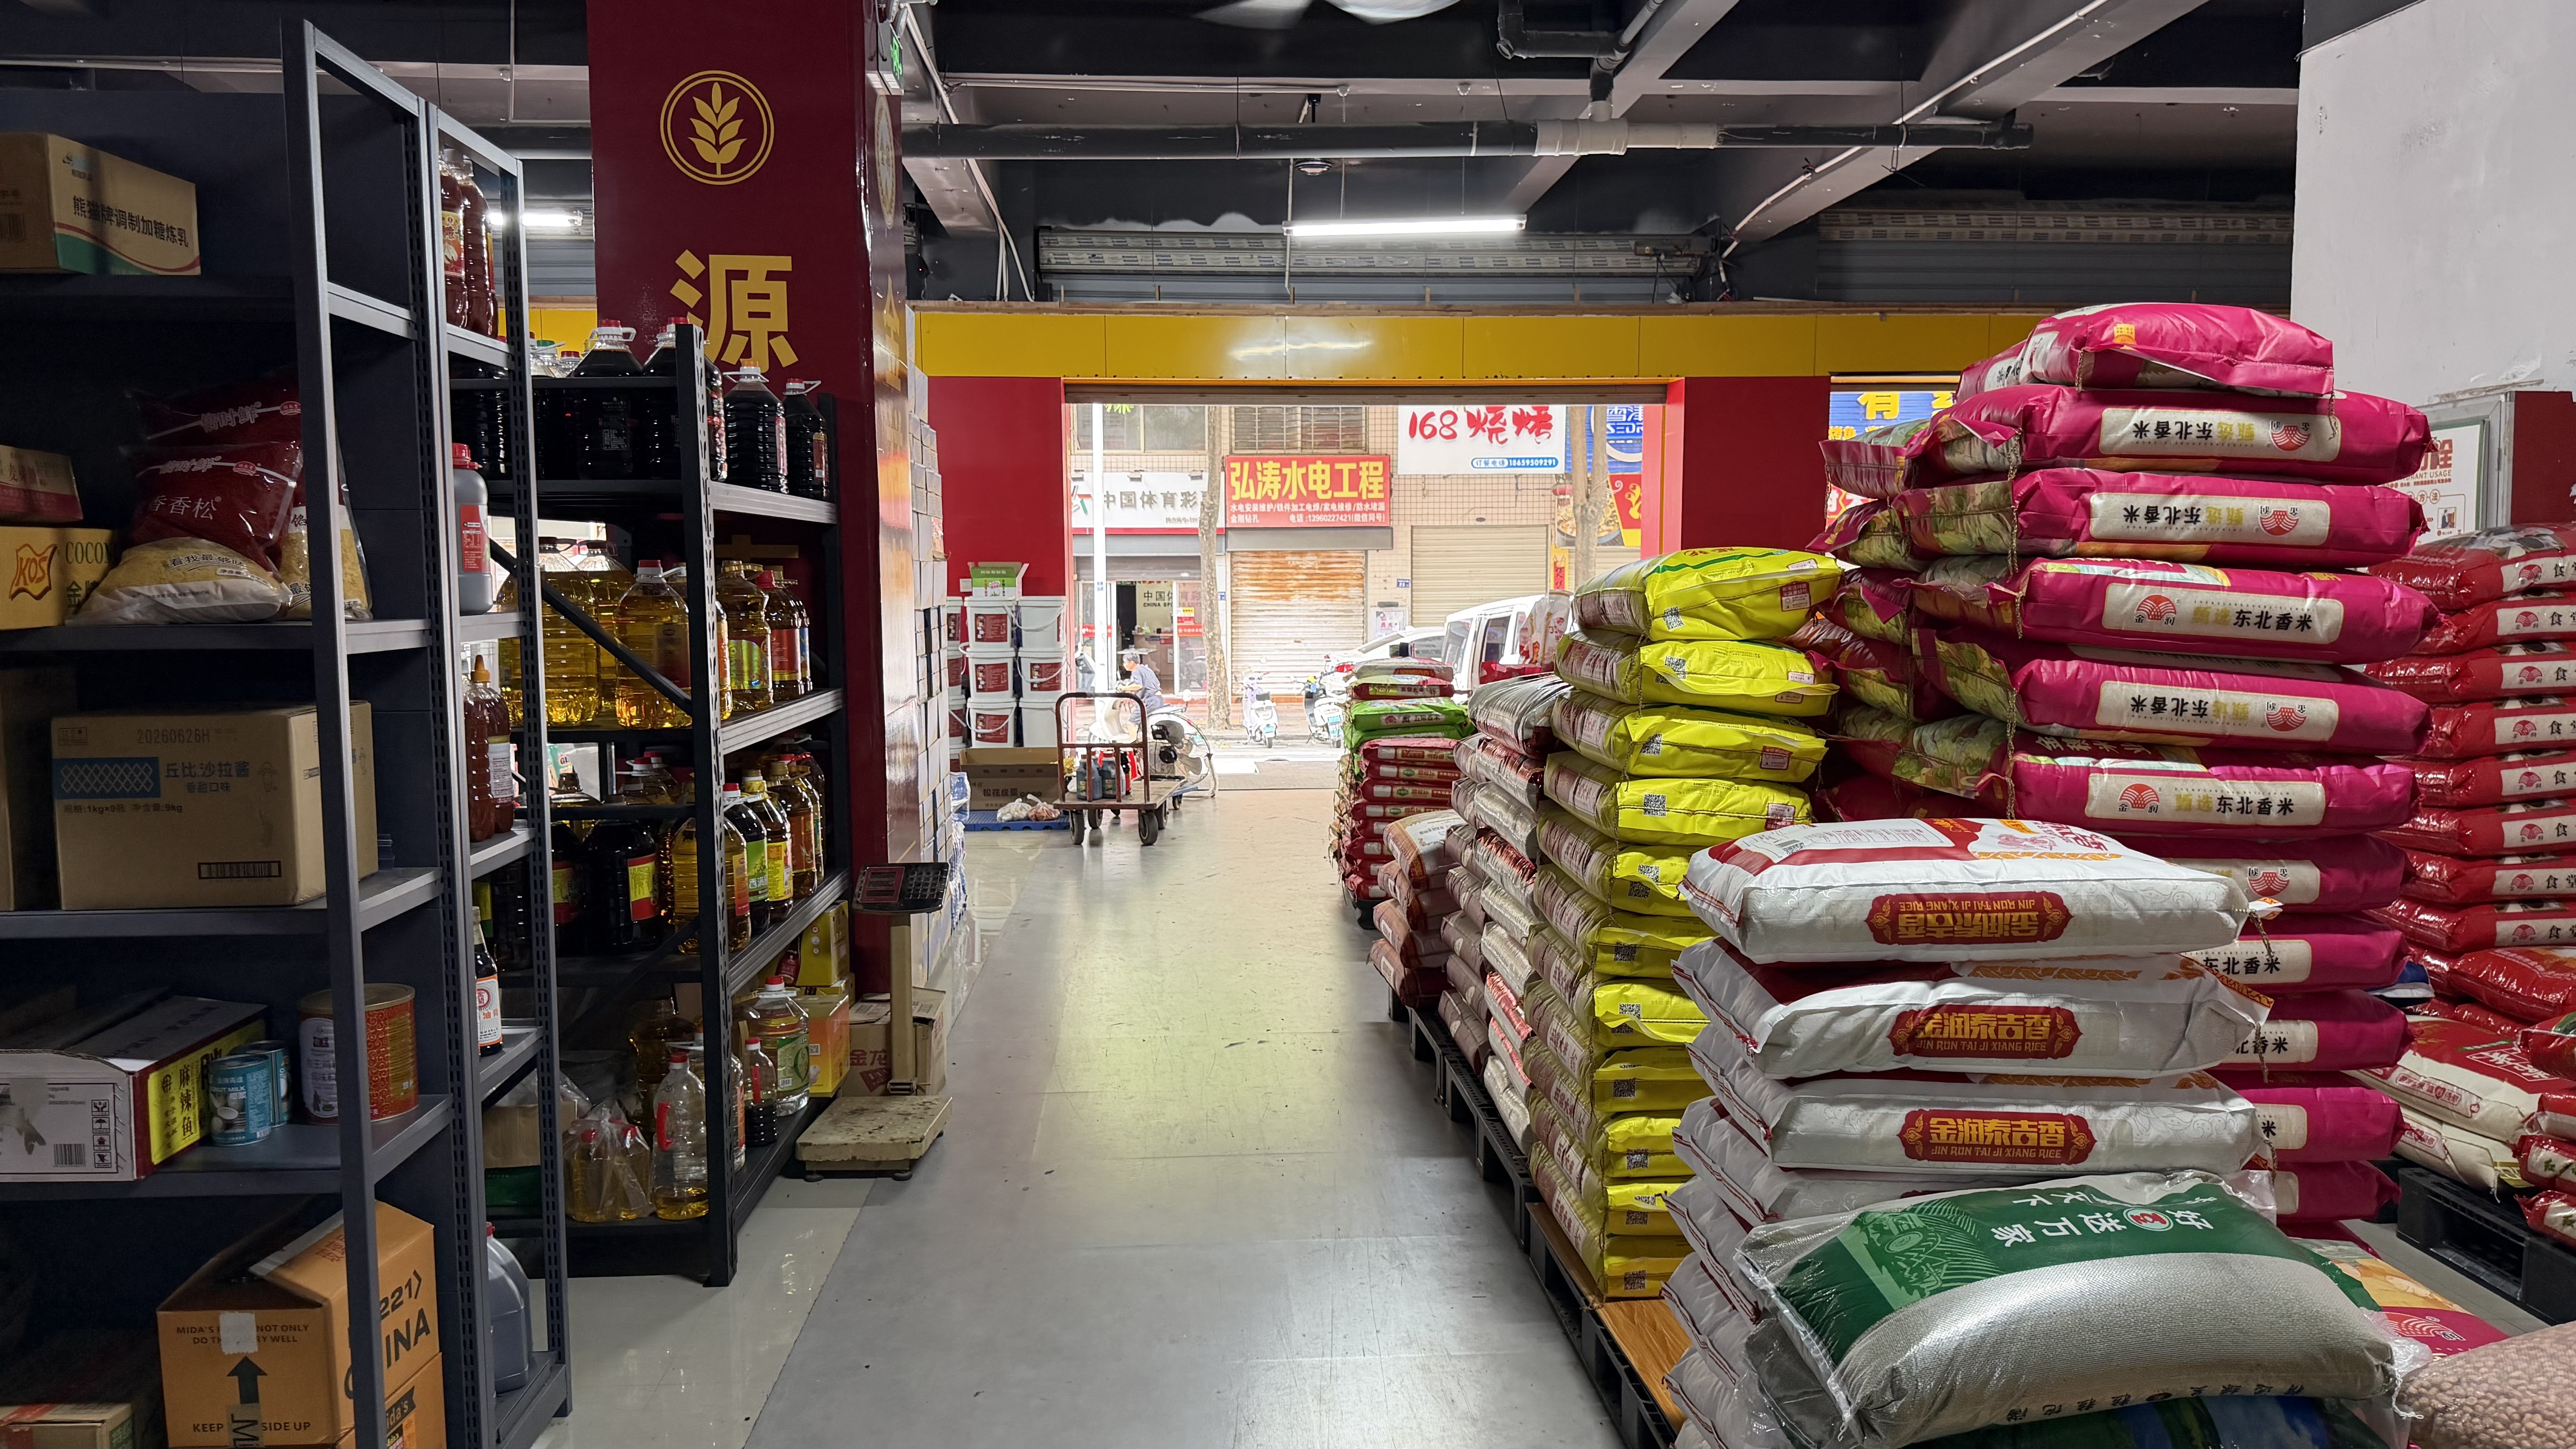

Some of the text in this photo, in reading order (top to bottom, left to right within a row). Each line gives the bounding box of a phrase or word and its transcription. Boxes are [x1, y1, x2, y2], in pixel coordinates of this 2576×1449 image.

[73, 196, 189, 247] 熊猫牌调制加糖炼乳
[669, 250, 799, 373] 源
[1409, 405, 1553, 445] 168烧烤
[1230, 461, 1384, 500] 弘涛水电工程
[2430, 469, 2452, 478] USAGE
[14, 556, 48, 587] KOS
[165, 761, 250, 778] 丘比沙拉酱
[1898, 901, 1923, 911] RICE
[1973, 901, 1991, 911] TAI
[2018, 899, 2035, 909] JIN
[1897, 912, 2039, 938] 金润泰吉香
[1918, 1012, 2050, 1040] 金润泰吉香
[1961, 1040, 1978, 1051] TAI
[1979, 1040, 1988, 1051] JI
[1991, 1040, 2023, 1051] XIANG
[2024, 1040, 2047, 1052] RICE
[1929, 1117, 2066, 1147] 金润泰吉香
[1932, 1147, 1948, 1156] JIN
[1975, 1148, 1991, 1158] TAI
[1993, 1149, 2002, 1158] JI
[2005, 1148, 2037, 1158] XIANG
[2039, 1149, 2061, 1159] RICE
[281, 1324, 309, 1332] ONLY
[193, 1421, 311, 1433] KEEP SIDE UP
